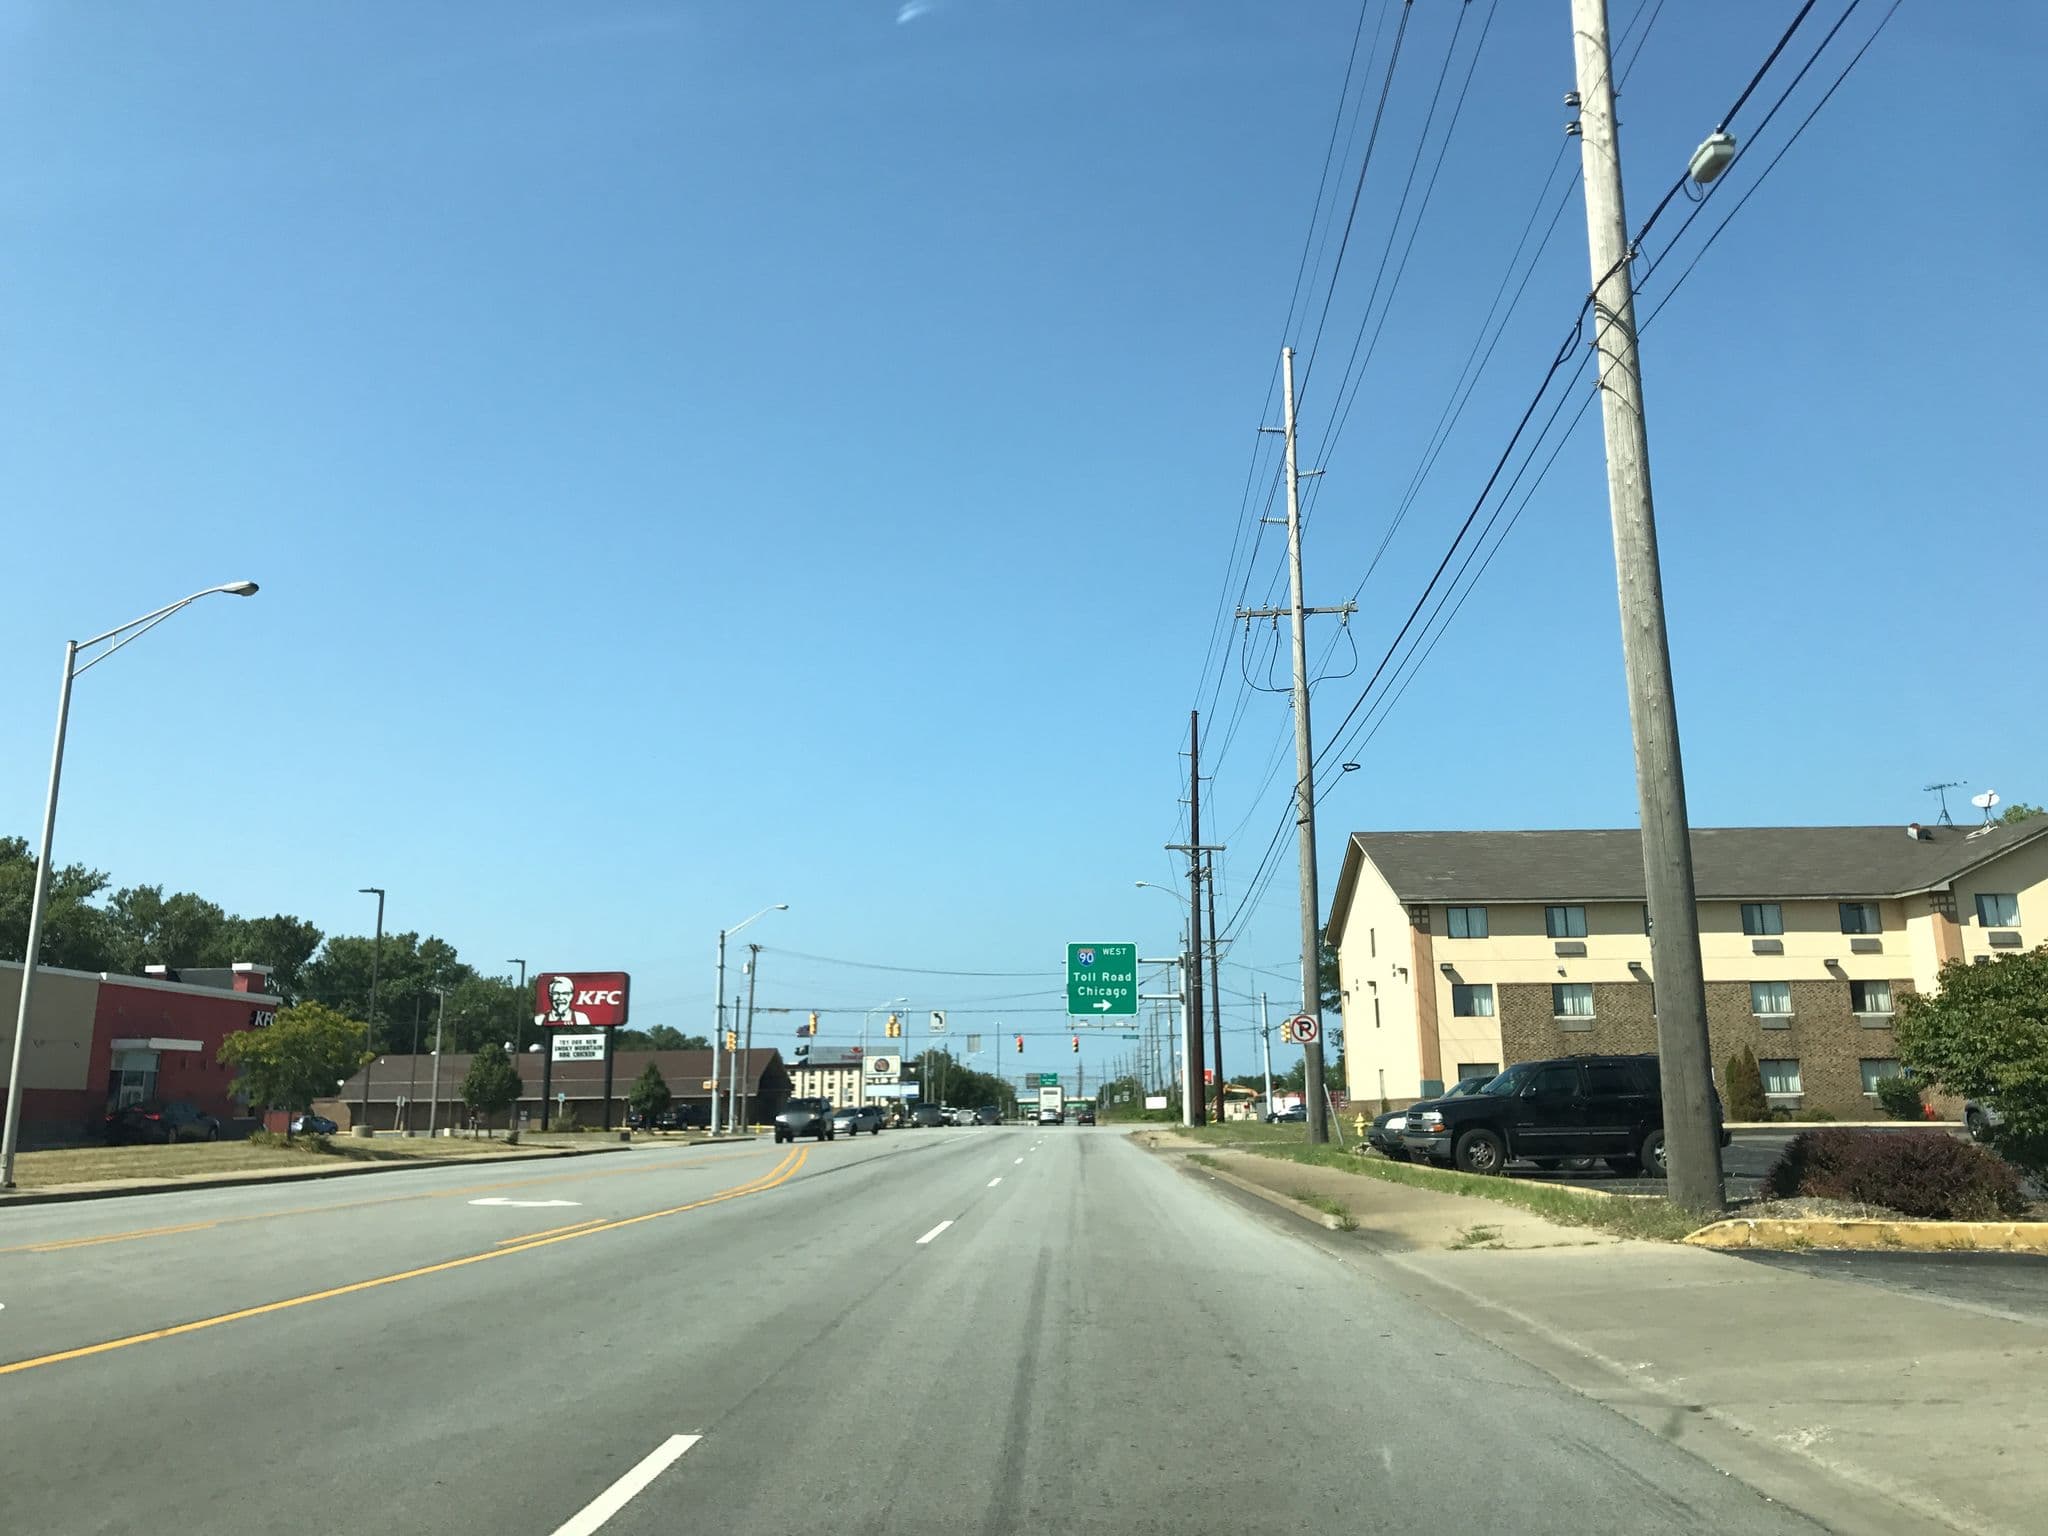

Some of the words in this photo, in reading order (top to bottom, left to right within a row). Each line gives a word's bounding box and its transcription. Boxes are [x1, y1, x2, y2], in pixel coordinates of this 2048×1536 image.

[1079, 953, 1094, 963] 90
[1102, 948, 1127, 956] WEST
[1073, 972, 1096, 982] Toll
[1102, 972, 1132, 982] Road
[576, 990, 622, 1005] KFC
[1078, 986, 1128, 998] Chicago
